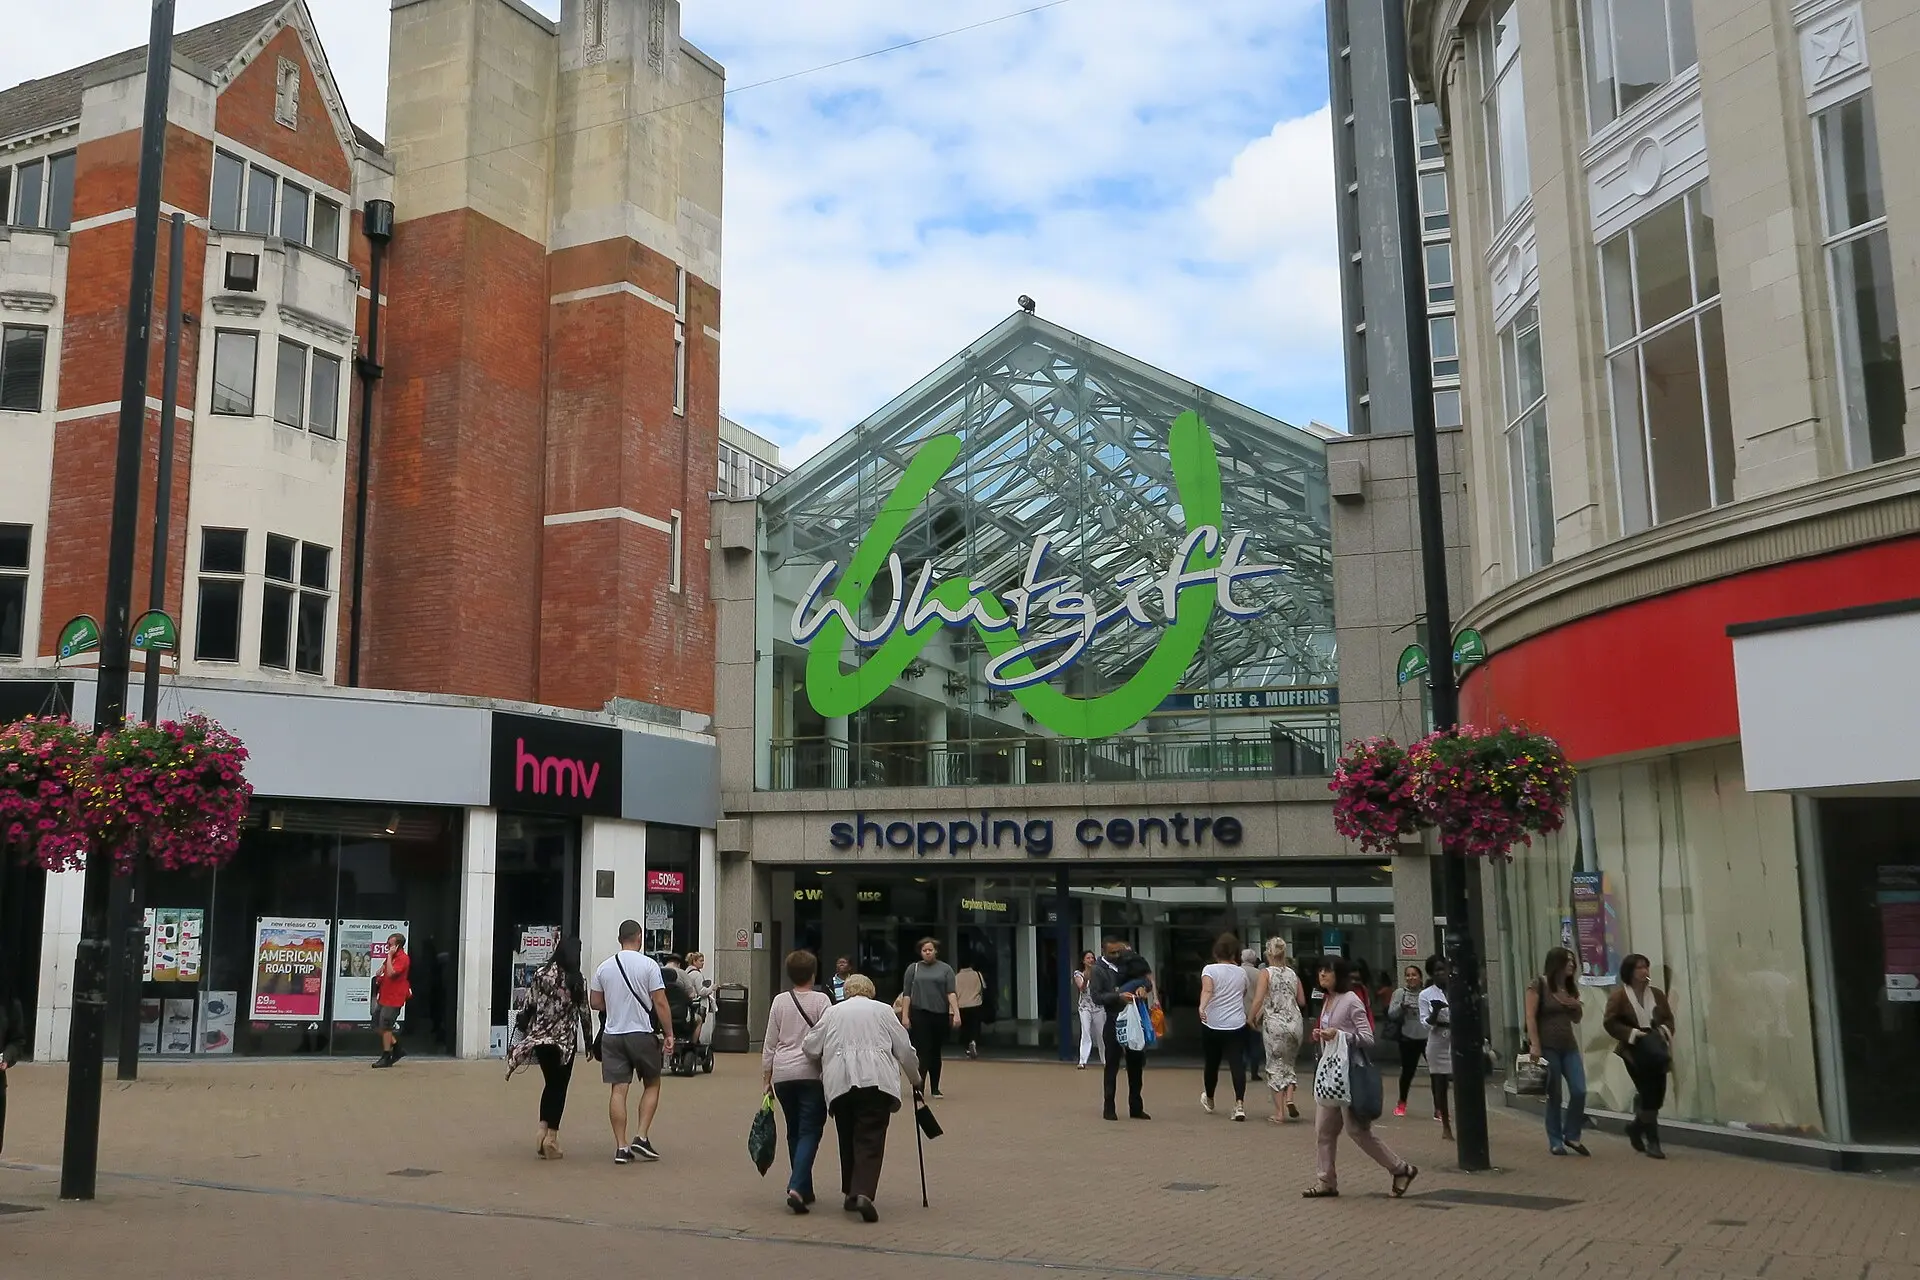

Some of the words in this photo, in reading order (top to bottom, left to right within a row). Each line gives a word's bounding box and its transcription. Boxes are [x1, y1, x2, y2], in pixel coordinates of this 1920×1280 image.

[790, 525, 1289, 690] Whitgift
[1249, 693, 1260, 707] &
[1265, 689, 1329, 706] MUFFINS
[516, 738, 600, 799] hmv
[829, 811, 1054, 854] shopping
[1075, 812, 1244, 847] centre
[658, 872, 677, 886] 50%
[523, 936, 551, 947] 1980s
[260, 950, 322, 962] AMERICAN
[265, 964, 292, 974] ROAD
[294, 964, 315, 974] TRIP
